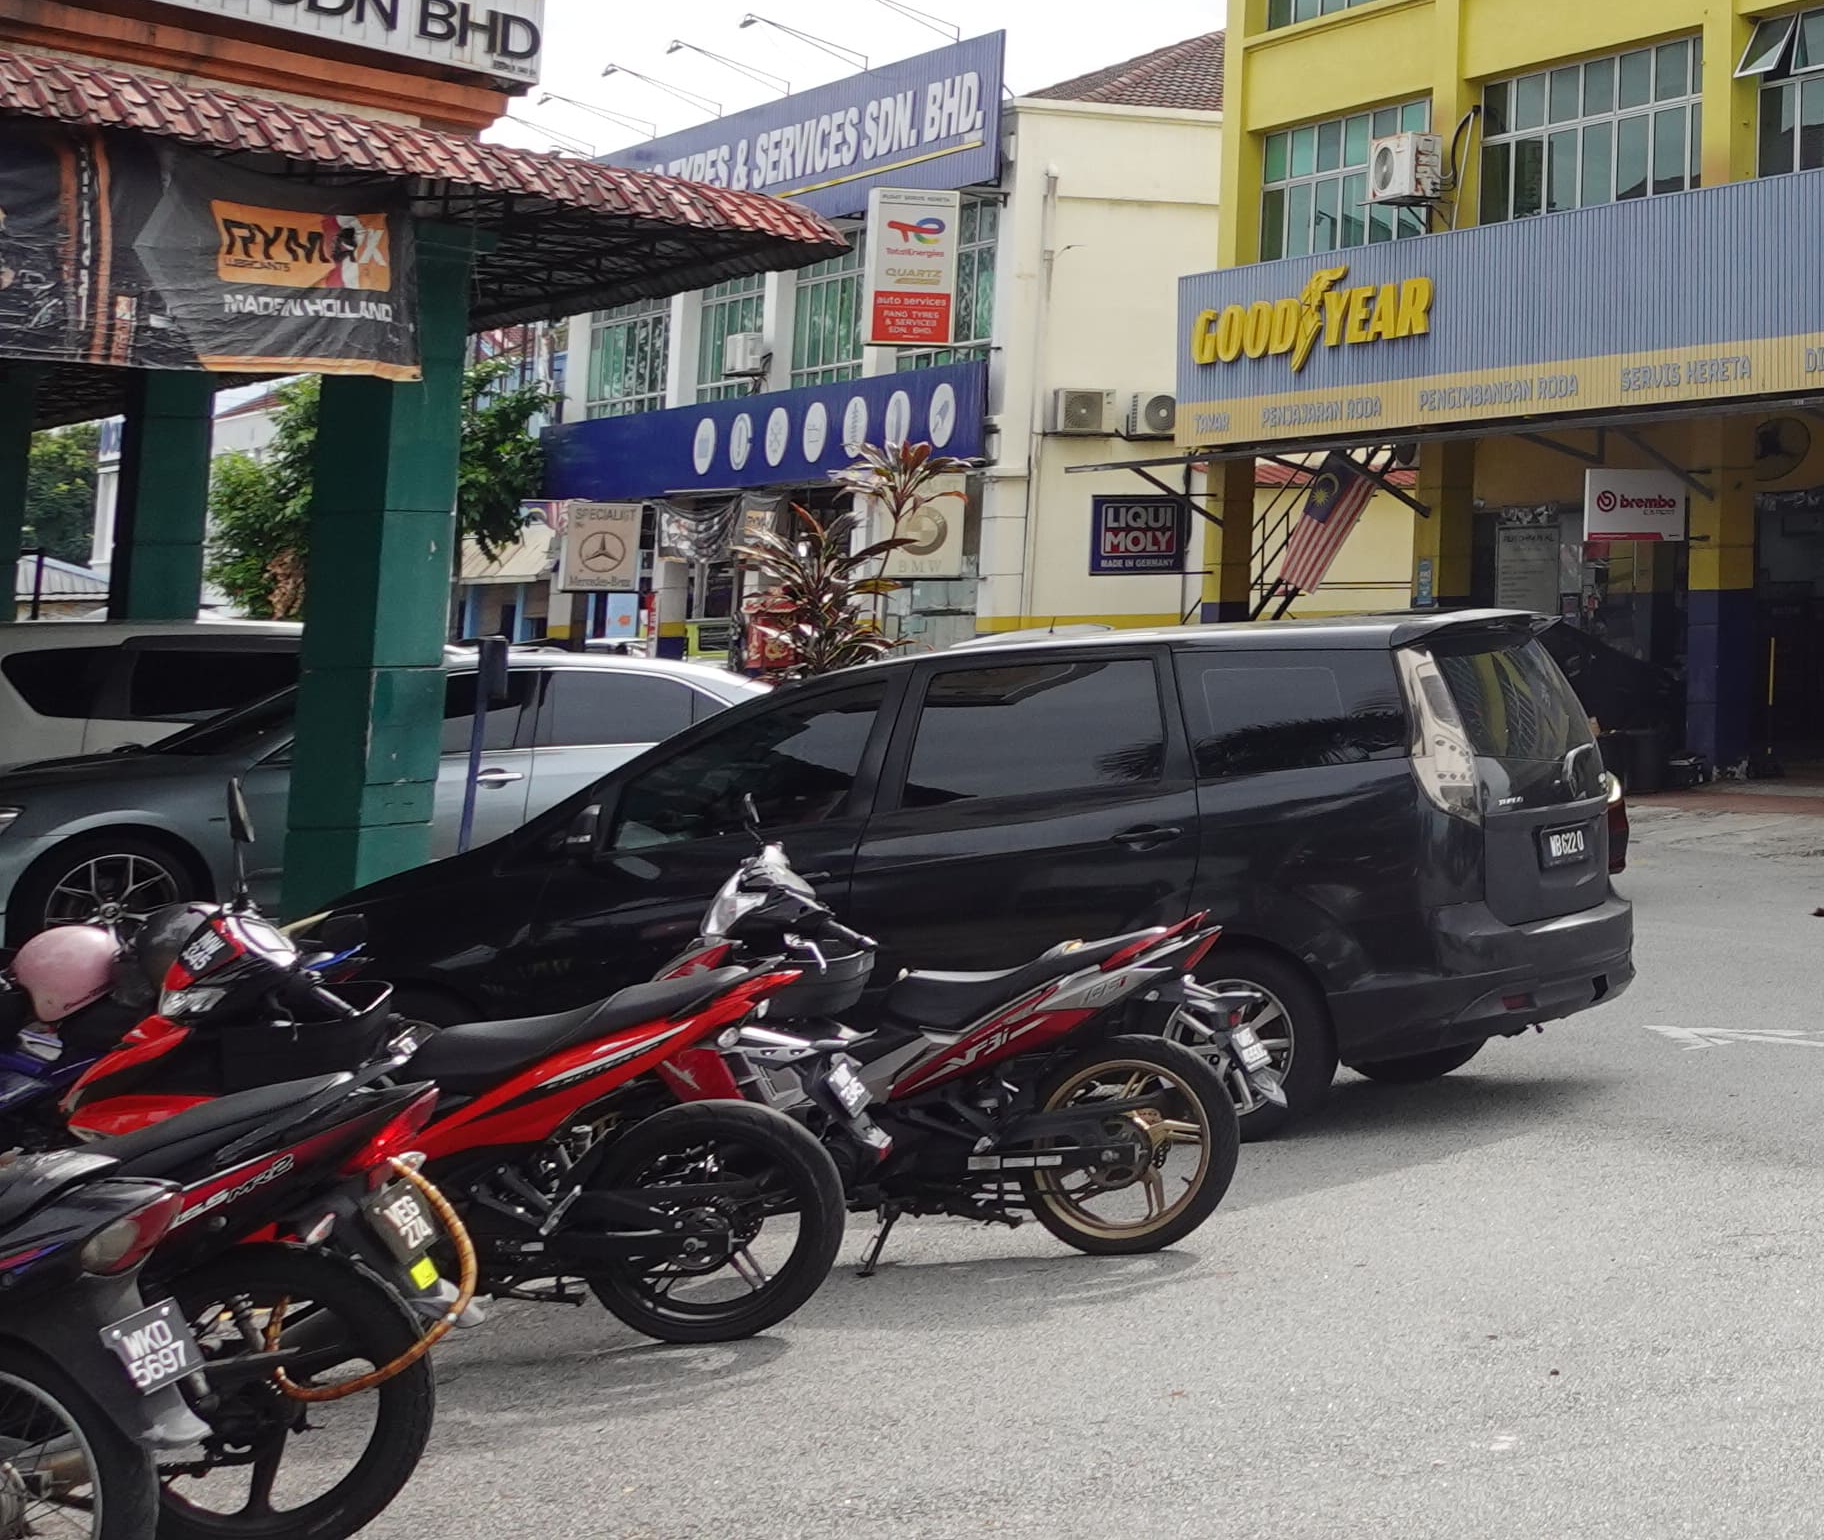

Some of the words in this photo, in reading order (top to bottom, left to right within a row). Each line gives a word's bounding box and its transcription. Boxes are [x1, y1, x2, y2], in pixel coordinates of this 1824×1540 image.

[732, 139, 749, 191] &
[752, 107, 861, 190] SERVICES
[862, 90, 917, 160] SDN.
[923, 71, 984, 143] BHD.
[222, 217, 387, 267] RYMAX
[885, 267, 943, 278] QUARTZ
[304, 298, 393, 322] HOLLAND
[876, 296, 901, 305] auto
[903, 297, 946, 307] services
[1191, 273, 1434, 368] GOODYEAR
[1620, 361, 1682, 392] SERVIS
[1686, 354, 1752, 386] KERETA
[1418, 378, 1533, 413] PENGIMBANGAN
[1537, 374, 1579, 402] RODA
[1194, 412, 1231, 434] TAYAR
[1261, 400, 1343, 428] PENJAJARAN
[1346, 394, 1383, 422] RODA
[1619, 494, 1676, 509] brembo
[575, 507, 636, 522] SPECIALIST
[1106, 506, 1172, 529] LIQUI
[1104, 531, 1174, 553] MOLY
[898, 559, 942, 574] BMW
[1101, 559, 1124, 568] MADE
[1135, 559, 1175, 568] GERMANY
[399, 1217, 435, 1251] 274
[123, 1318, 172, 1360] WKD
[131, 1343, 190, 1388] 5697
